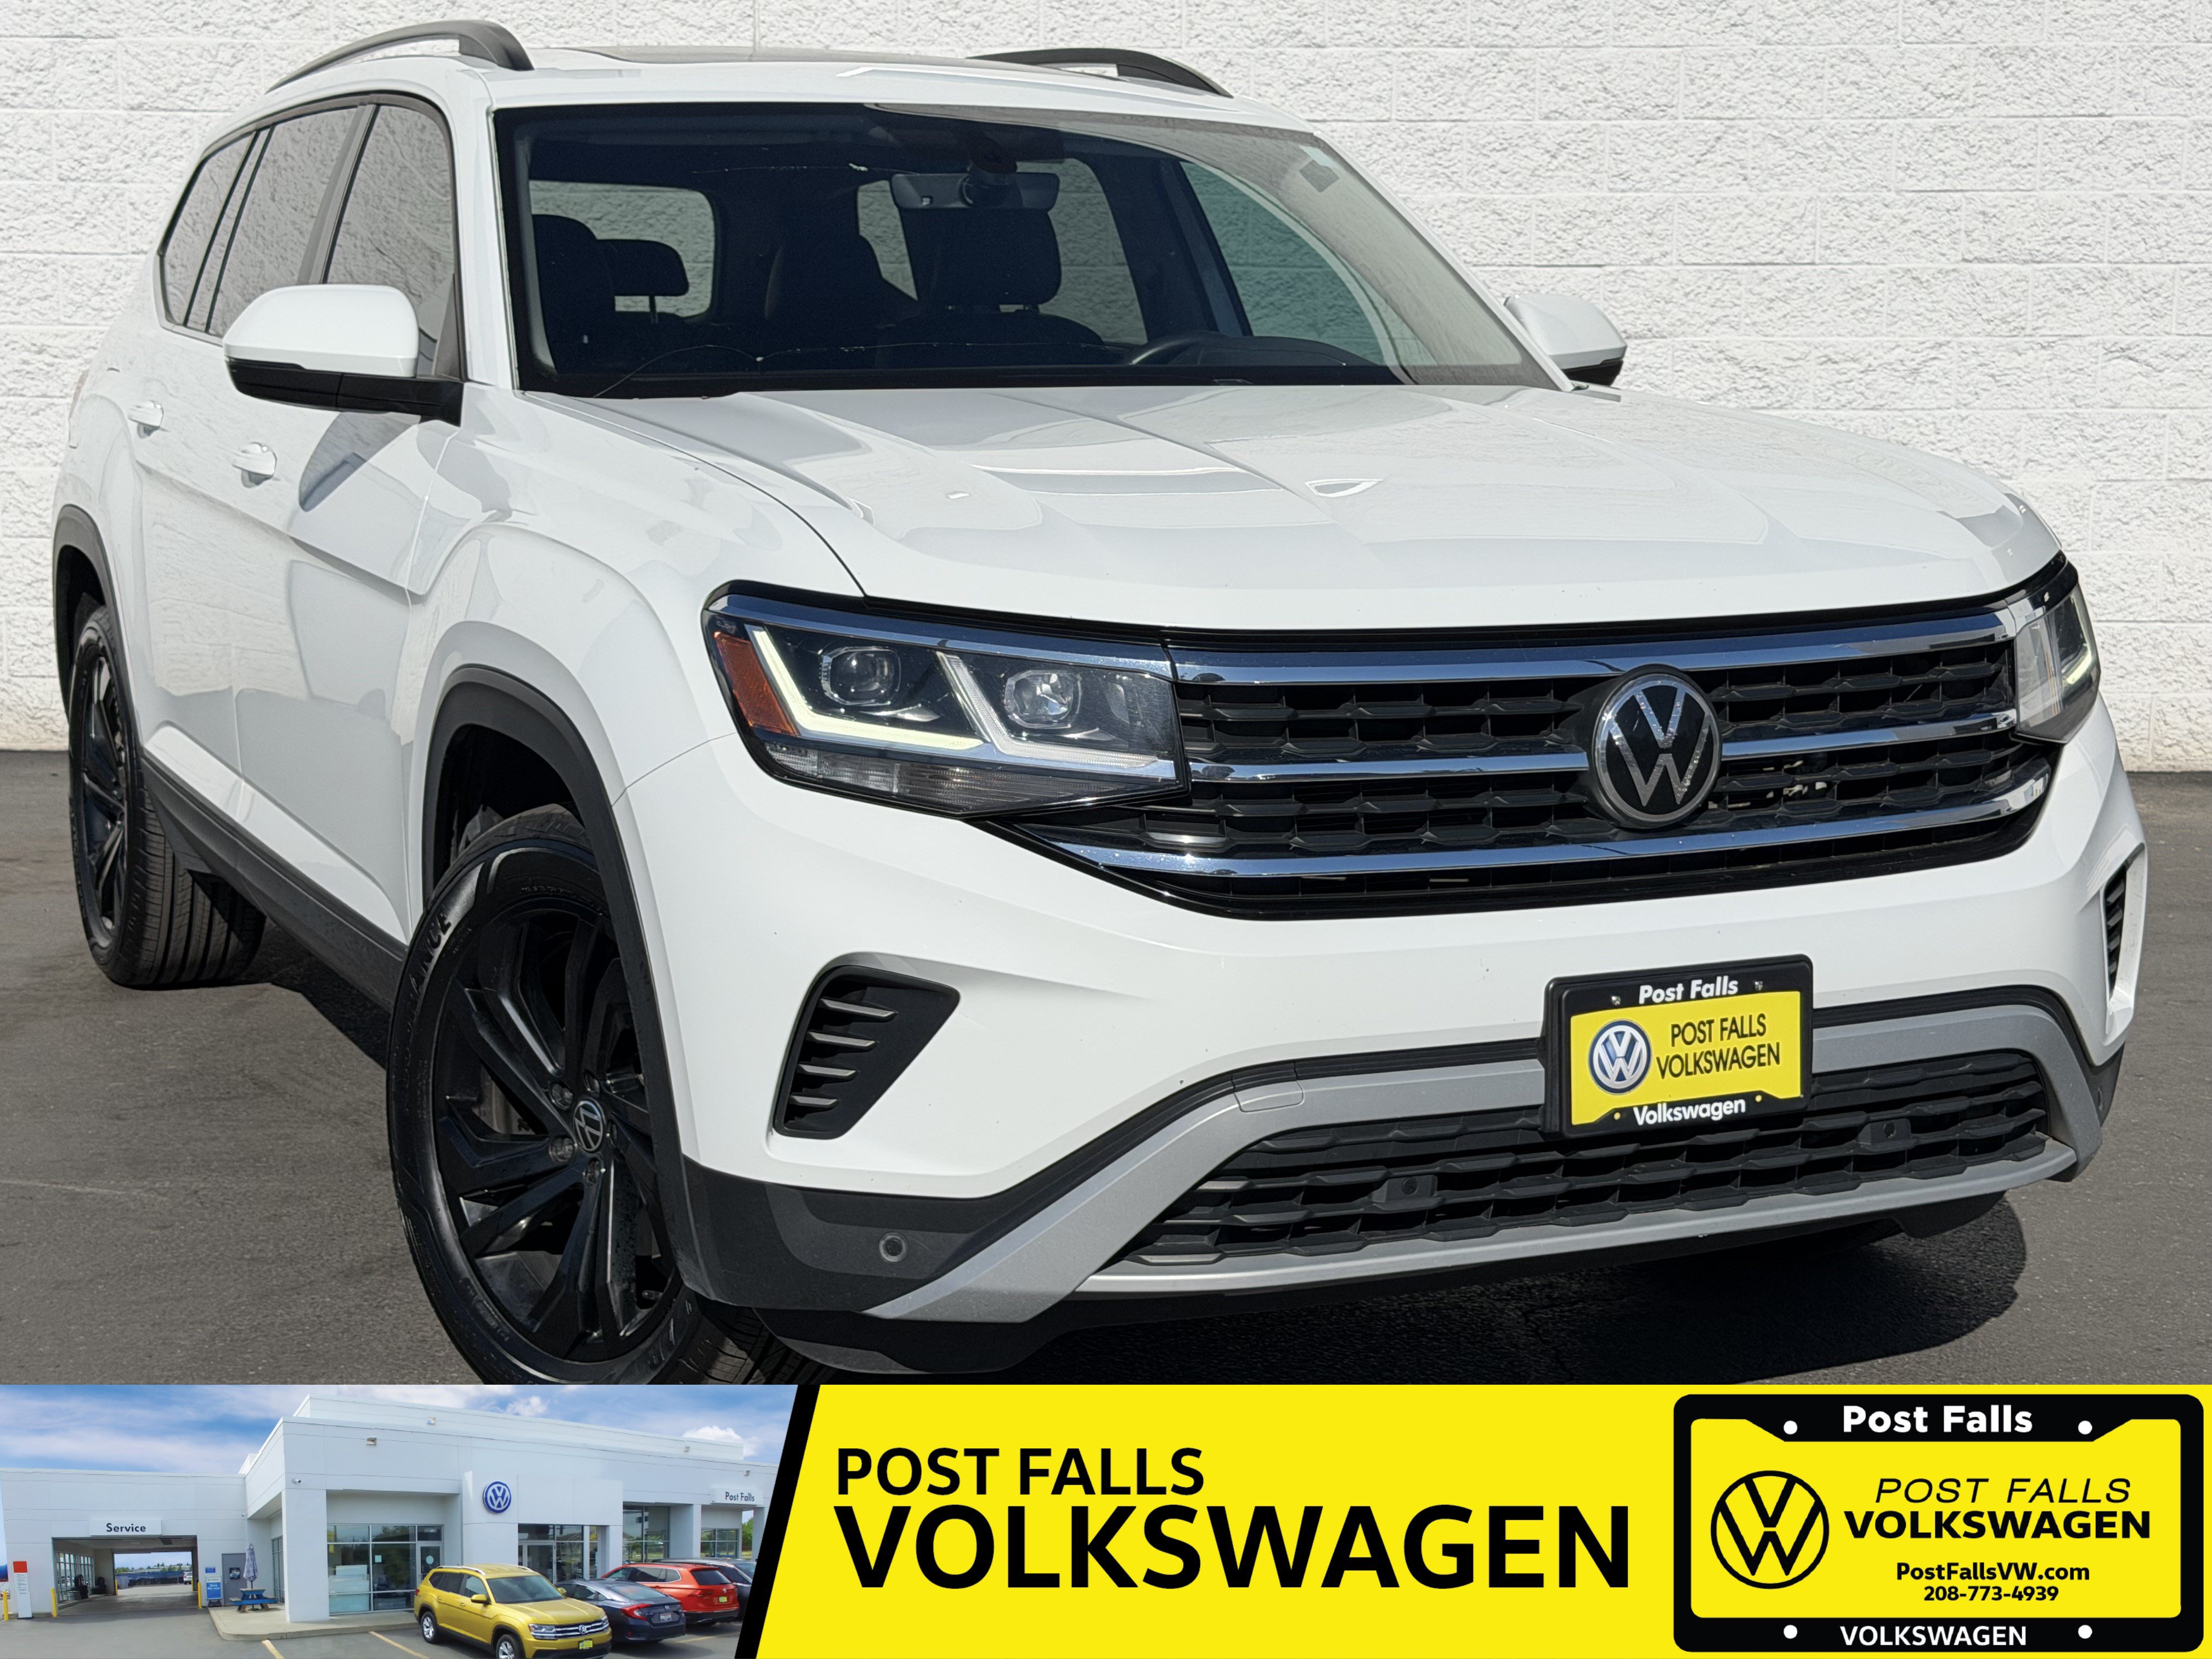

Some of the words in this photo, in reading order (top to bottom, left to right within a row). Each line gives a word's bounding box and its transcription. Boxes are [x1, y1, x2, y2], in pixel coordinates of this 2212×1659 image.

[1598, 678, 1717, 815] VW
[1639, 983, 1684, 1005] Post
[1690, 975, 1739, 1000] Falls
[1671, 1018, 1715, 1047] POST
[1720, 1013, 1767, 1041] FALLS
[1593, 1025, 1647, 1089] VW
[1656, 1042, 1780, 1080] VOLKSWAGEN
[1633, 1098, 1746, 1126] Volkswagen
[487, 1483, 510, 1510] VW
[725, 1491, 739, 1501] Post
[740, 1492, 755, 1502] Falls
[106, 1522, 146, 1532] Service
